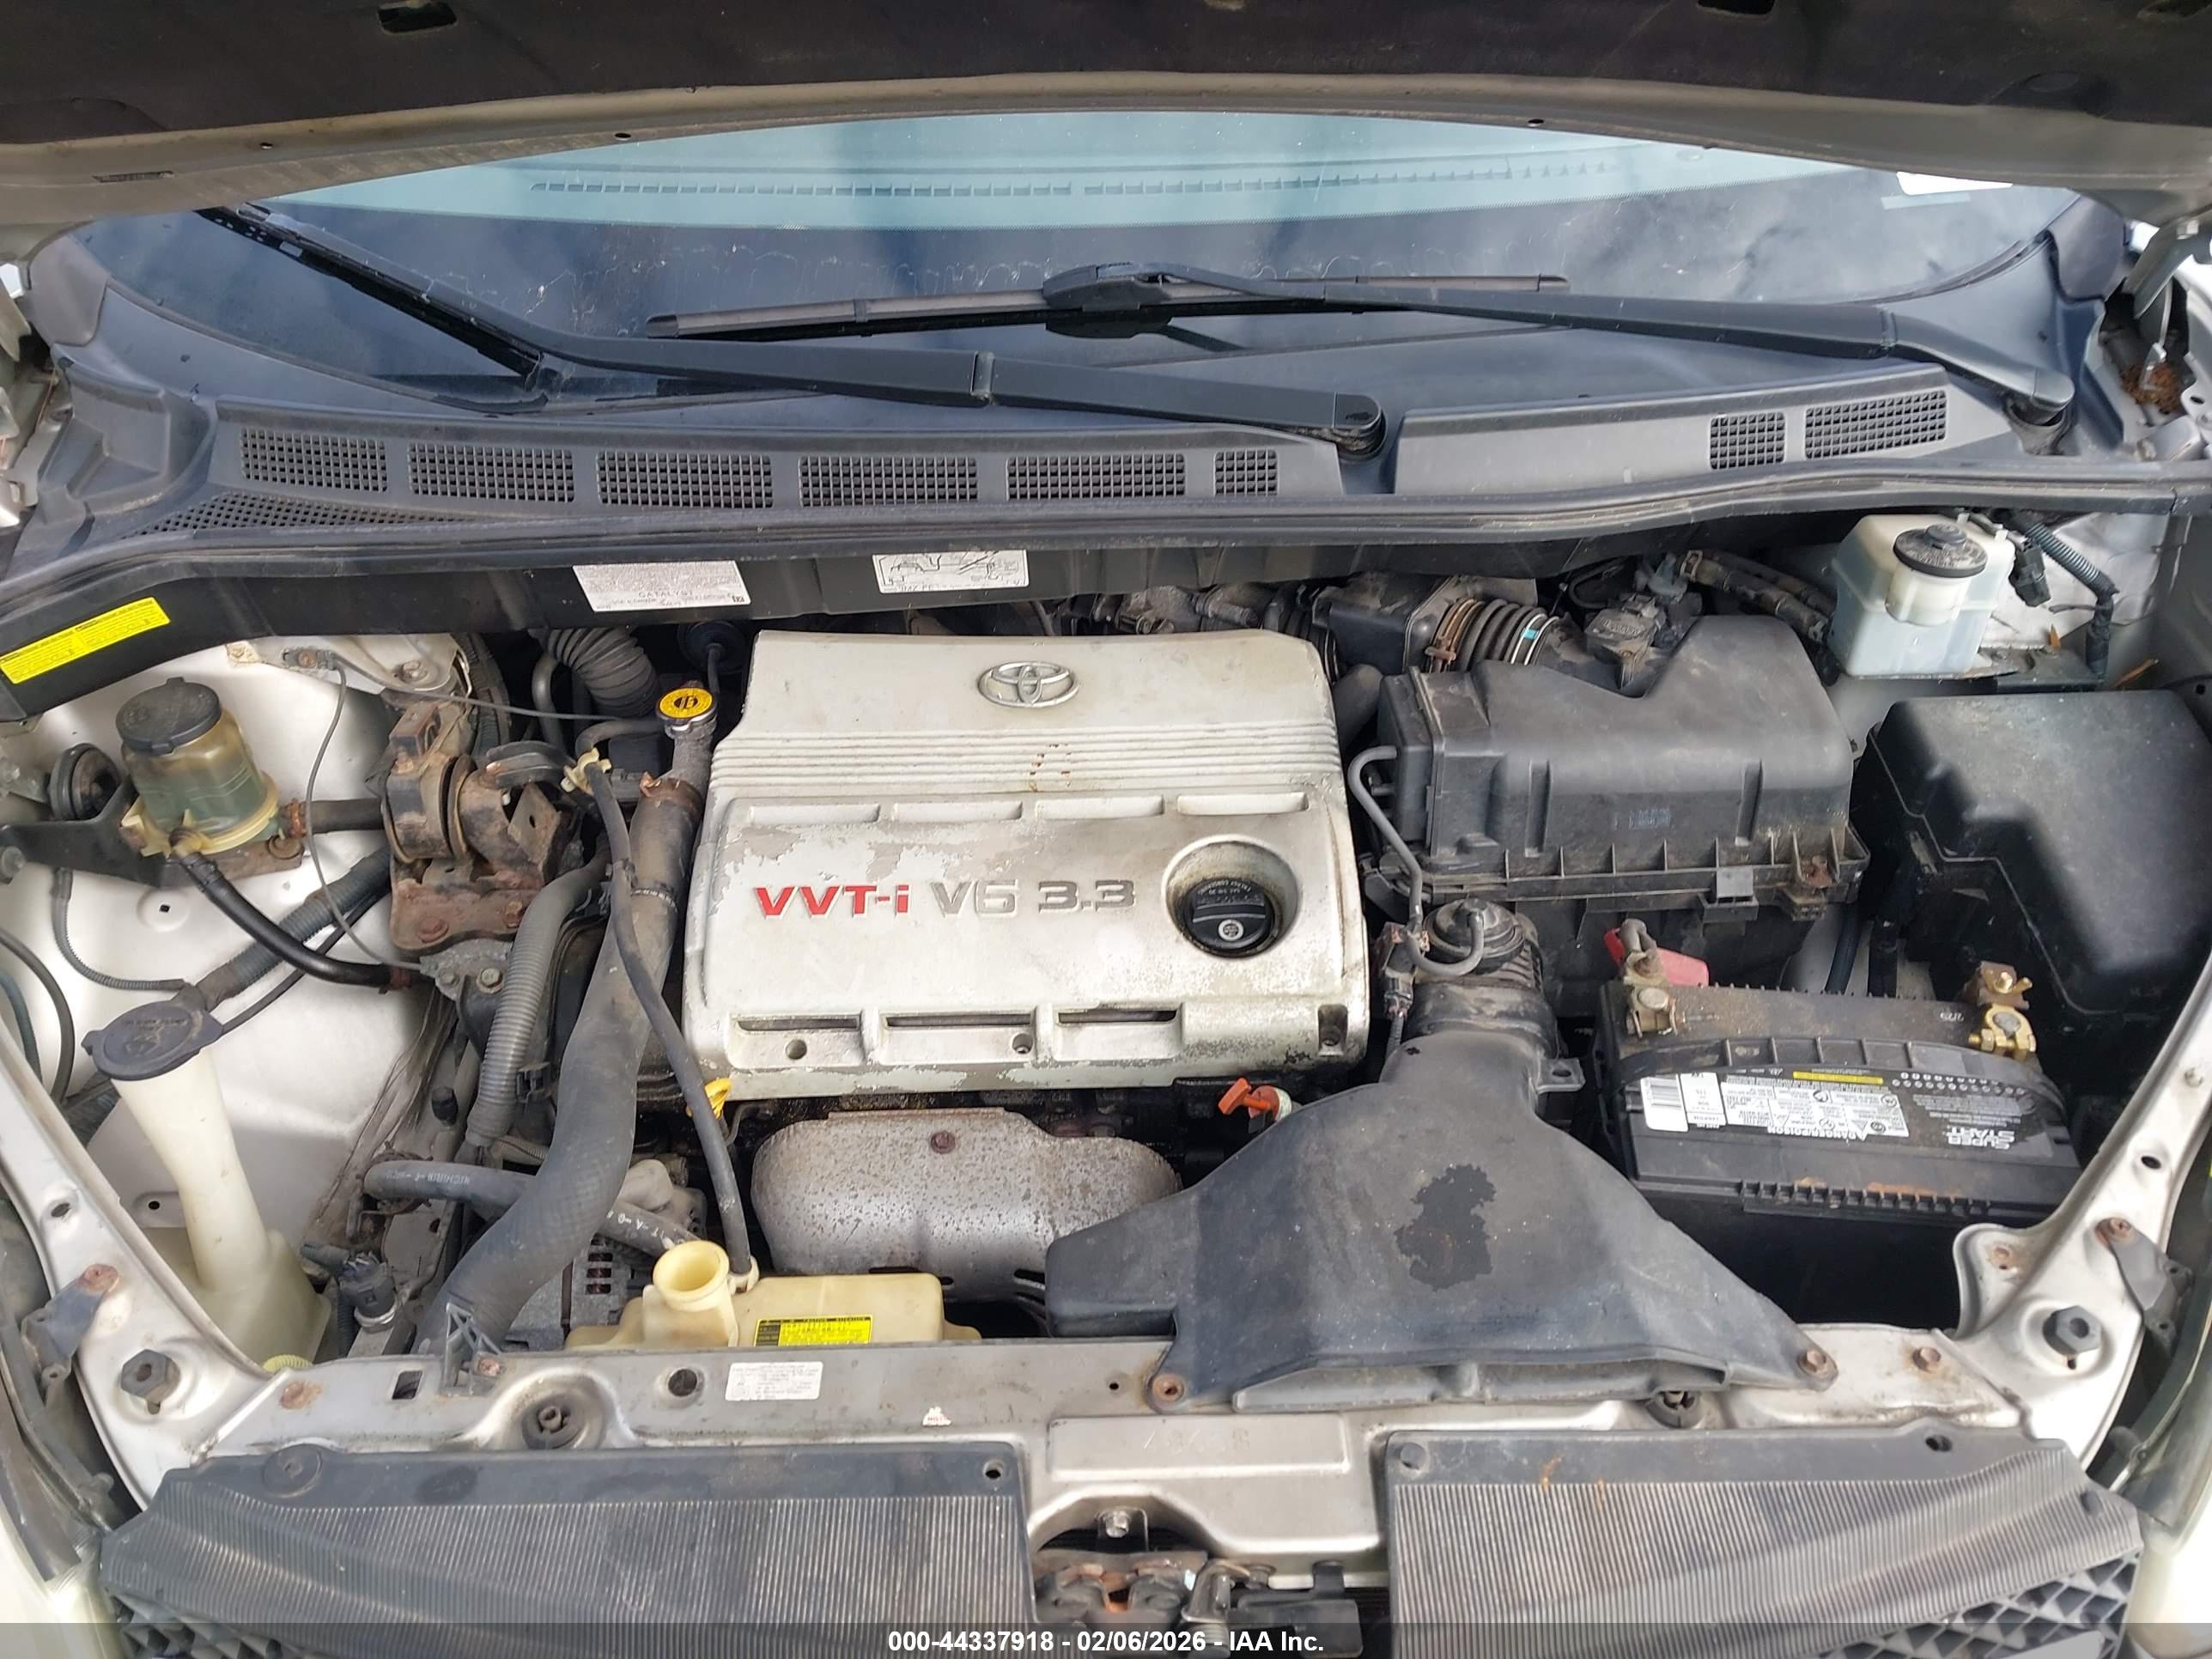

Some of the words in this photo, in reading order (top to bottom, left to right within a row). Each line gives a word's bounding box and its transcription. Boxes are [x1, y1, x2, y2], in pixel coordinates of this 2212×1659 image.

[755, 884, 911, 918] VVT-i
[932, 879, 1019, 916] V6
[1038, 878, 1135, 913] 3.3
[1767, 1127, 1857, 1140] DANGER/POISON
[1946, 1127, 2015, 1143] START
[1948, 1135, 2010, 1151] SUPER
